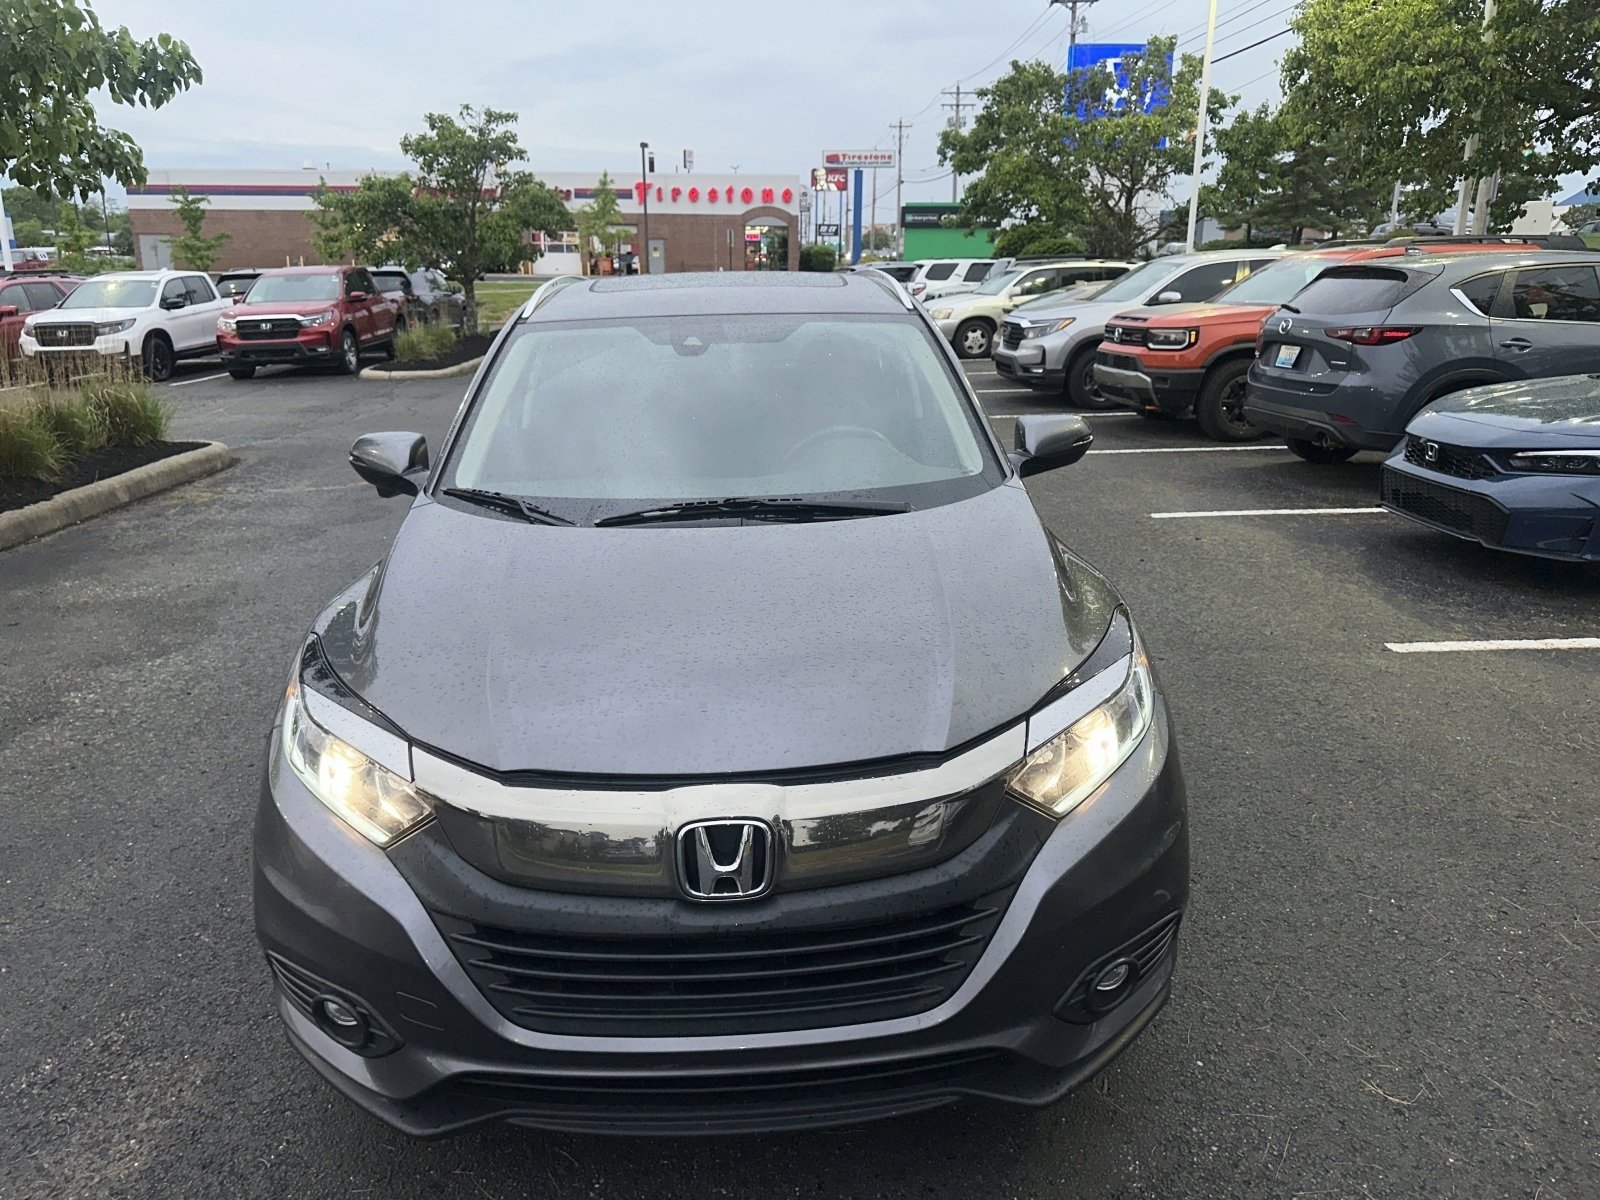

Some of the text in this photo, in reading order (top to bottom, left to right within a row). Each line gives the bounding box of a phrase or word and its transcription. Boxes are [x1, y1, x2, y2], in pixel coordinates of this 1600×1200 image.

[841, 153, 893, 161] Firestone
[827, 174, 846, 182] KFC
[634, 182, 793, 205] Firestone
